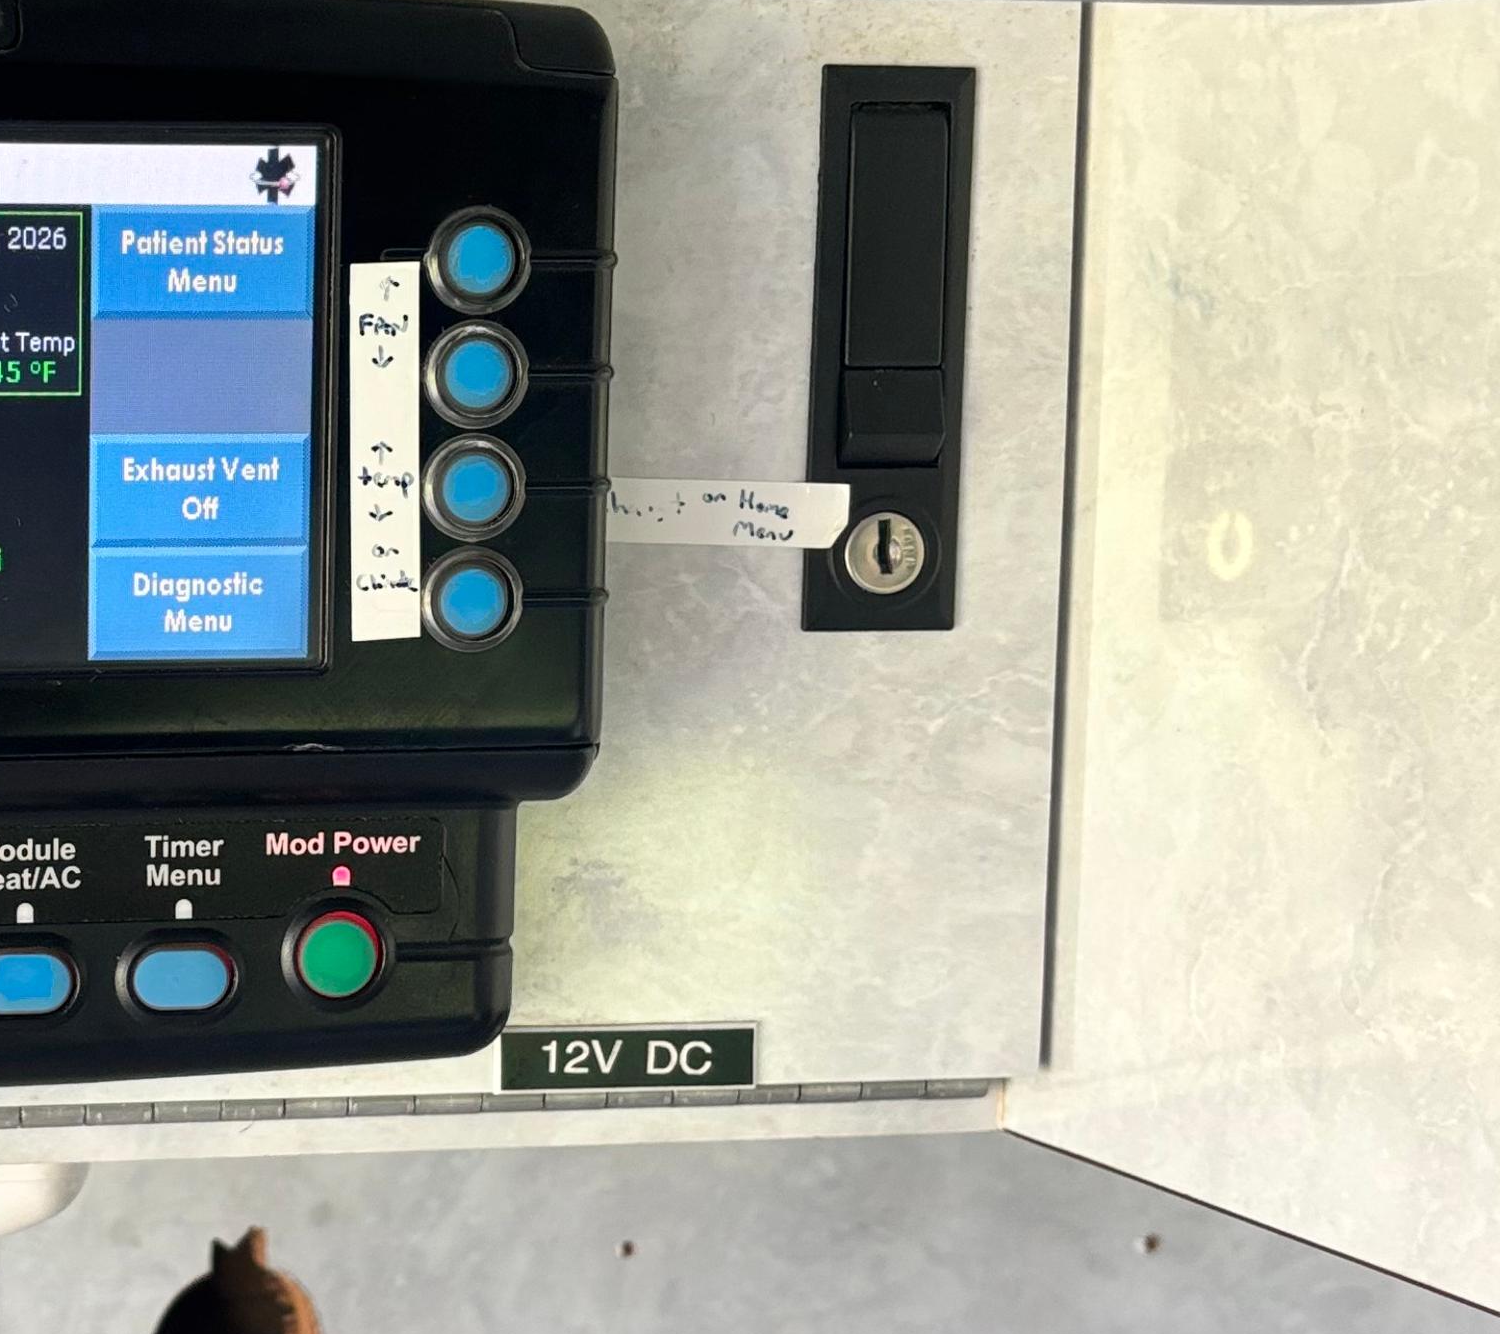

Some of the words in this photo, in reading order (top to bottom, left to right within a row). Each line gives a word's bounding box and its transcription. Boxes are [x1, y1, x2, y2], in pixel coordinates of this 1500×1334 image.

[5, 226, 68, 251] 2026
[120, 229, 210, 256] Patient
[212, 230, 284, 256] Status
[166, 269, 238, 294] Menu
[14, 332, 76, 356] Temp
[122, 457, 216, 483] Exhaust
[220, 457, 281, 483] Vent
[181, 496, 220, 522] Off
[132, 572, 264, 603] Diagnostic
[163, 609, 233, 635] Menu
[143, 834, 225, 860] Timer
[264, 831, 328, 857] Mod
[332, 831, 422, 856] Power
[145, 861, 222, 888] Menu
[540, 1038, 624, 1075] 12V
[645, 1039, 713, 1076] DC
